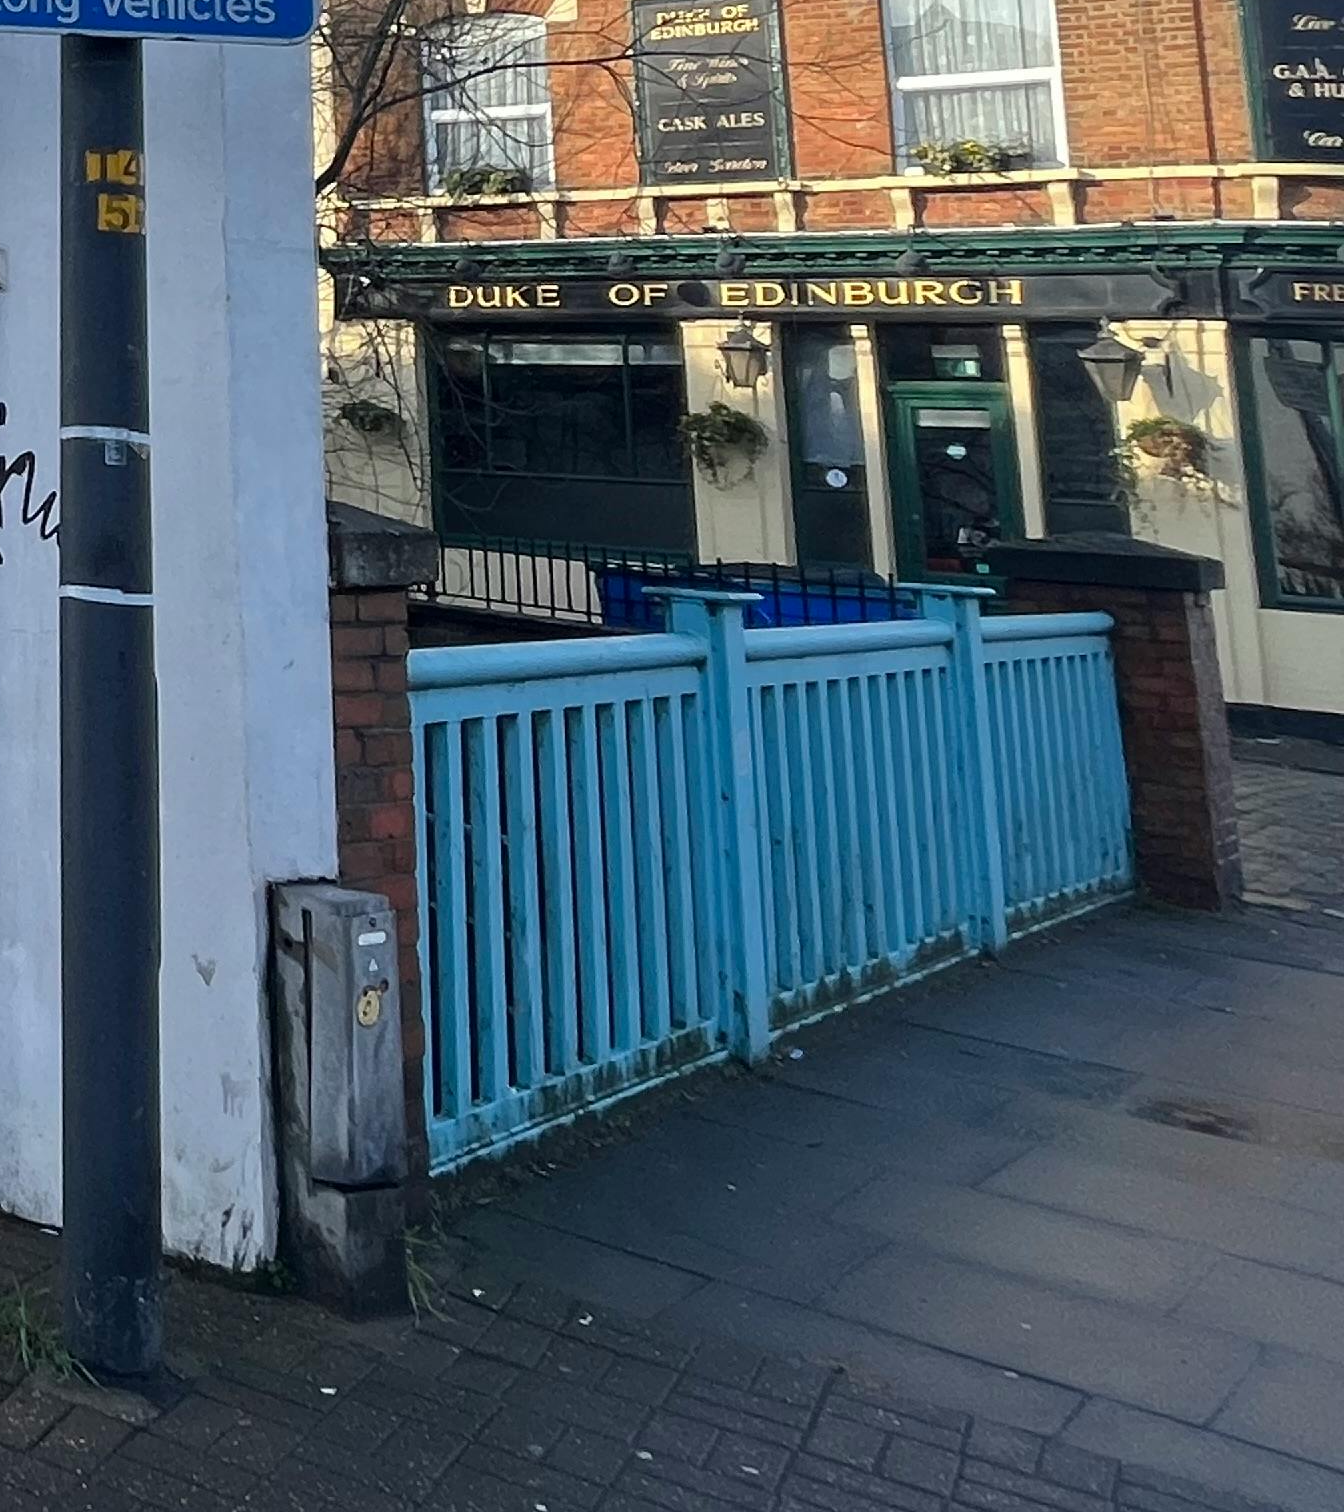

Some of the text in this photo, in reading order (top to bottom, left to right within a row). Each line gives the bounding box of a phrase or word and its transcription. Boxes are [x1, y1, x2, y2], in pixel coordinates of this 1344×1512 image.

[721, 4, 750, 19] OF
[650, 18, 760, 40] EDINBURGH
[1288, 82, 1306, 98] &
[658, 112, 766, 133] CASK ALES
[448, 279, 1024, 309] DUKE OF EDINBURGH
